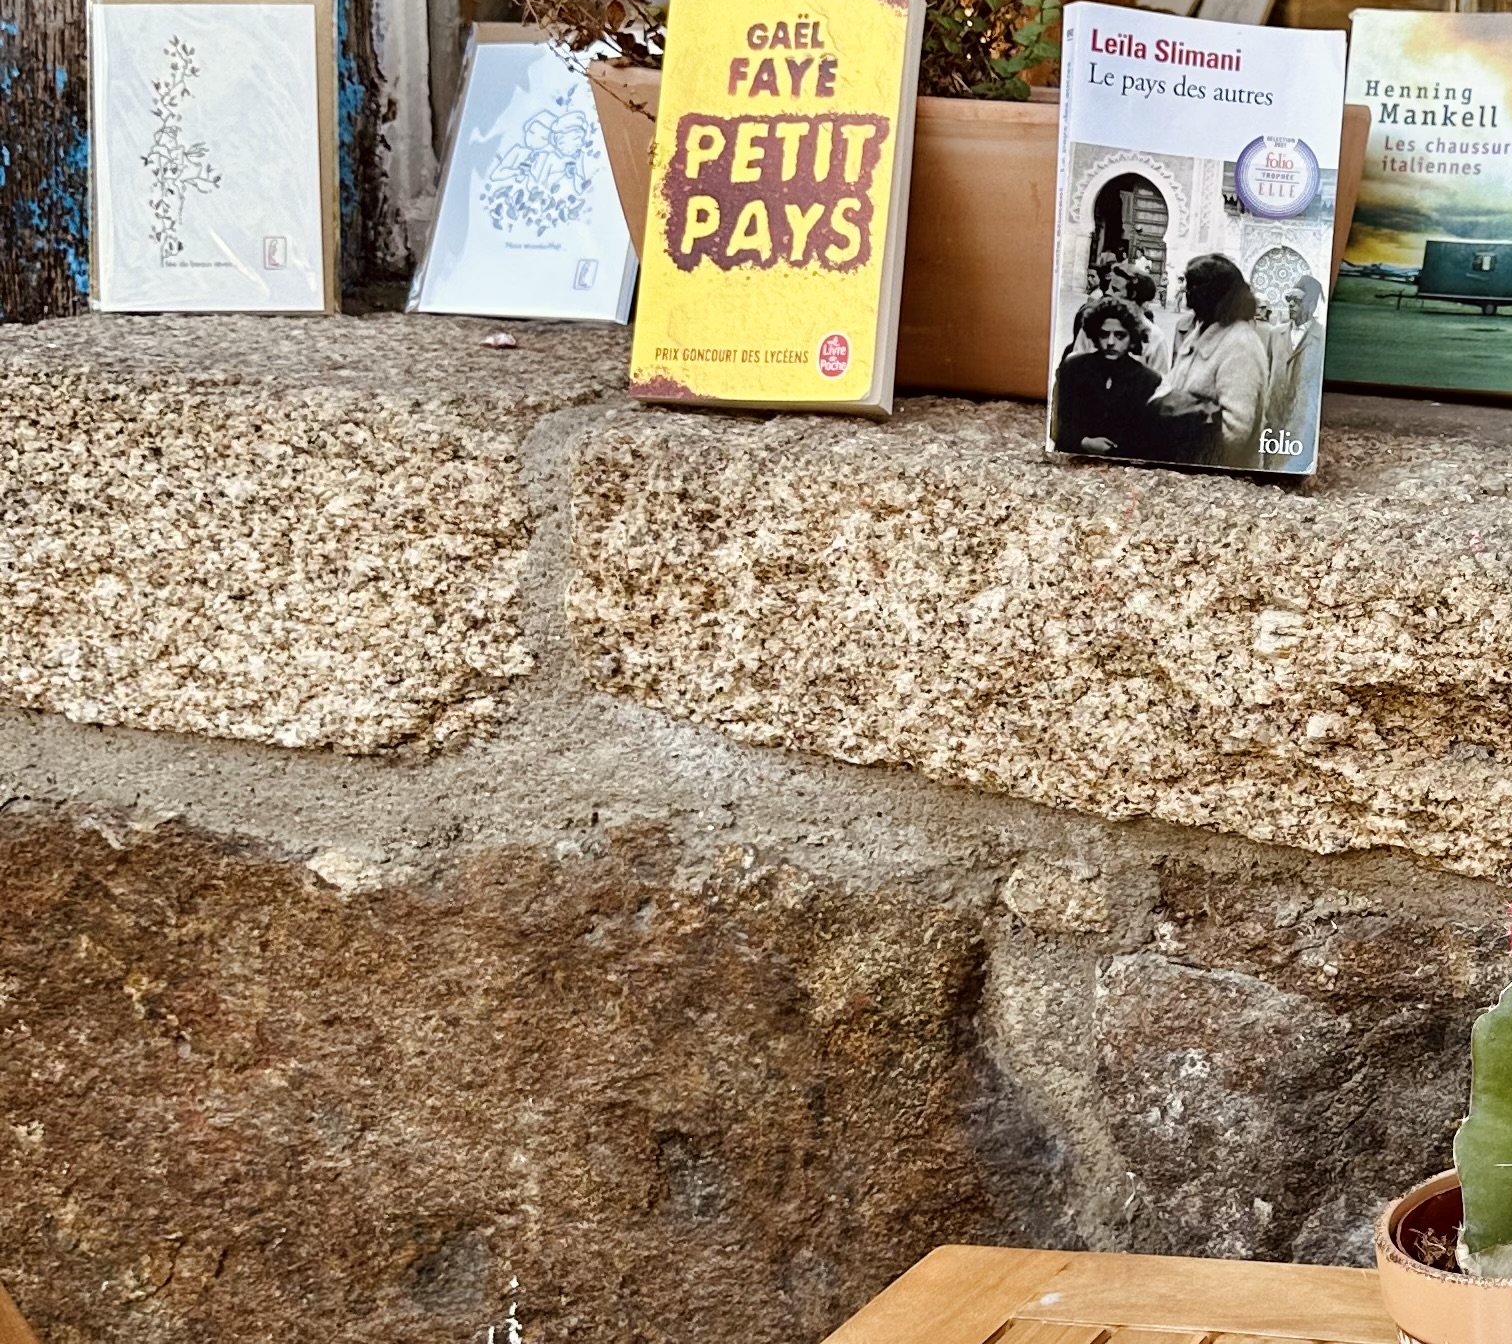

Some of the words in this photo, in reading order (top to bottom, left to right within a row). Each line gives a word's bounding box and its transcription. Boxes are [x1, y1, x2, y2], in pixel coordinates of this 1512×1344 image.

[746, 14, 825, 52] GAËL
[1090, 28, 1147, 61] Leïla
[1154, 37, 1243, 73] Slimani
[727, 54, 839, 98] FAYE
[1088, 61, 1115, 87] Le
[1120, 71, 1167, 100] pays
[1173, 73, 1207, 100] des
[1212, 85, 1274, 107] autres
[1365, 79, 1473, 105] Henning
[1378, 103, 1498, 129] Mankell
[685, 122, 876, 184] PETIT
[1384, 135, 1416, 153] Les
[1265, 151, 1294, 170] folio
[1381, 155, 1482, 176] italiennes
[1258, 182, 1297, 199] ELLE
[680, 193, 863, 263] PAYS
[655, 347, 679, 361] PRIX
[682, 348, 738, 364] GONCOURT
[741, 349, 761, 364] DES
[764, 348, 809, 364] LYCÉENS
[1258, 428, 1304, 457] folio
